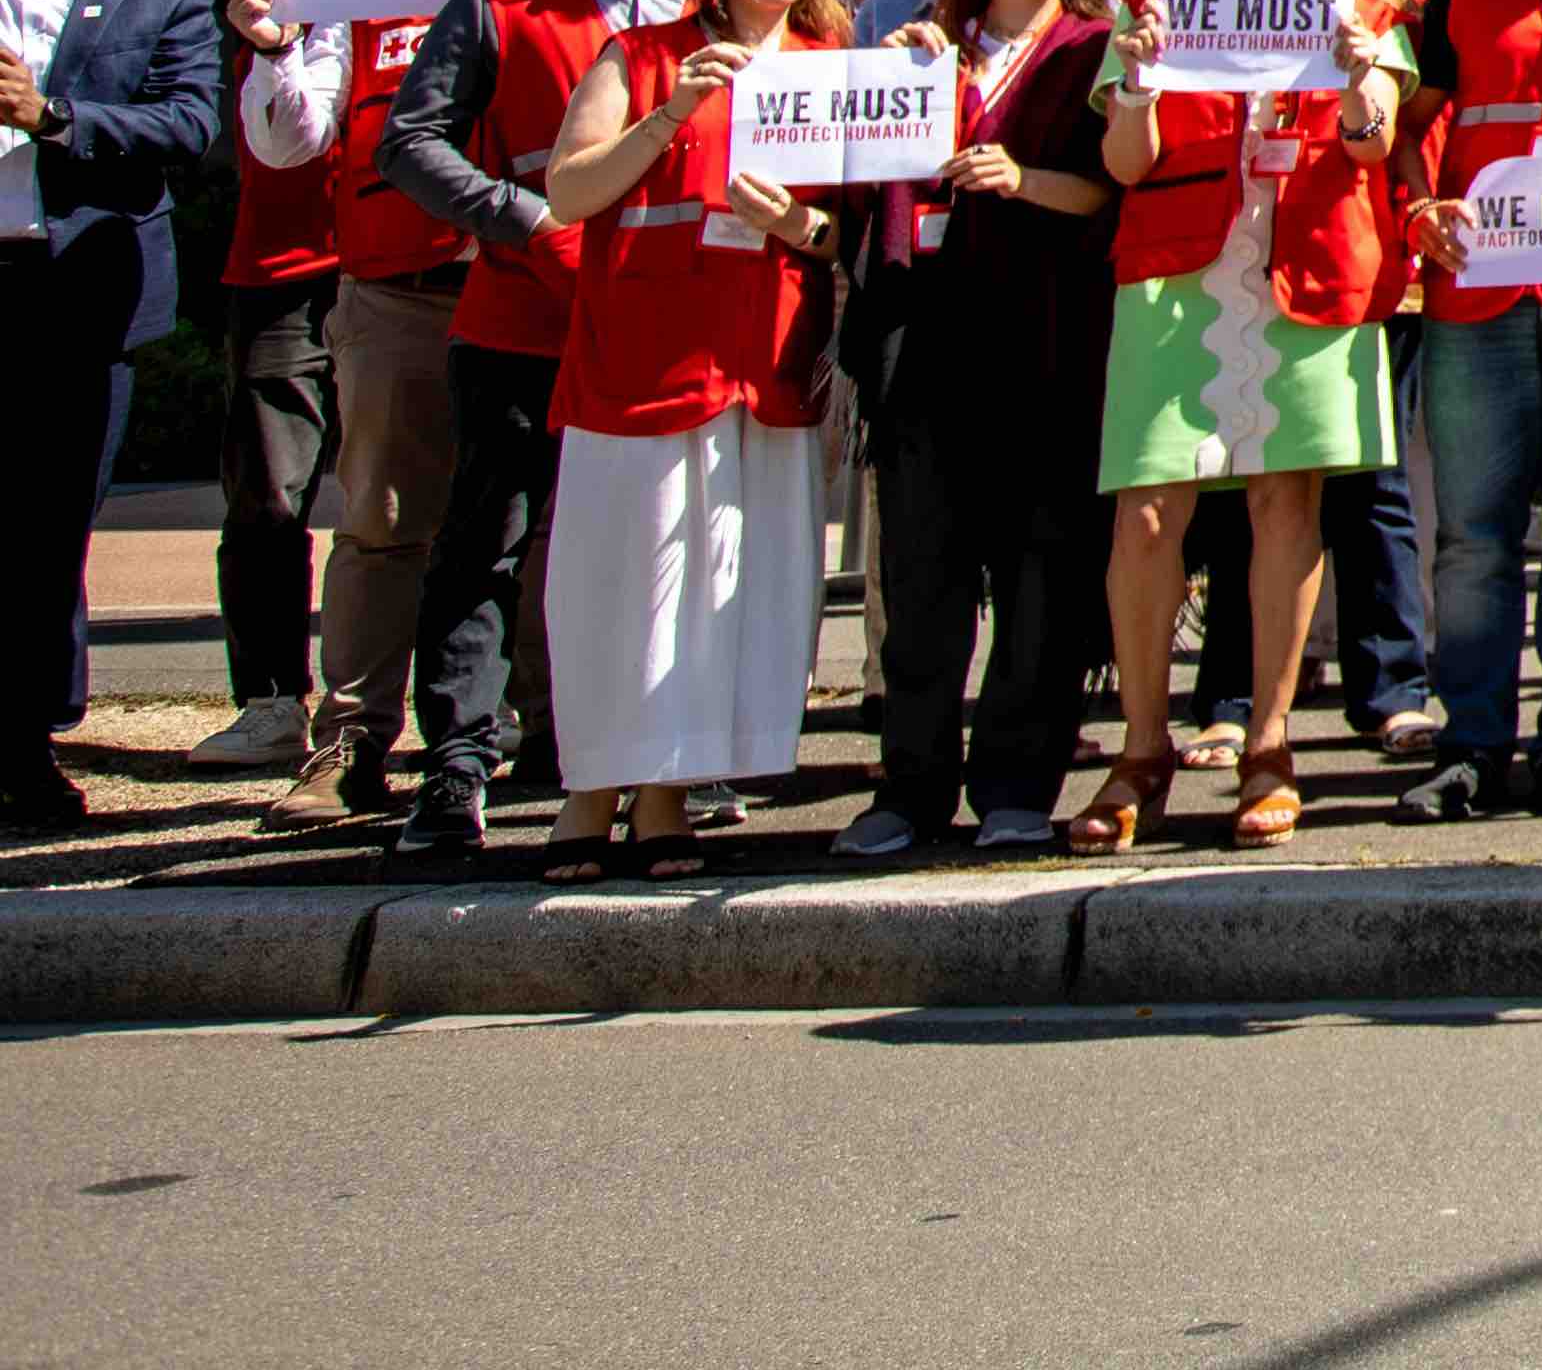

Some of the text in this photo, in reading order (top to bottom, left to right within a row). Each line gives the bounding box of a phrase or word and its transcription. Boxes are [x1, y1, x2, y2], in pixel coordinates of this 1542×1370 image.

[755, 86, 935, 124] WE MUST
[752, 123, 933, 145] #PROTECTHUMANITY
[1478, 196, 1526, 228] WE
